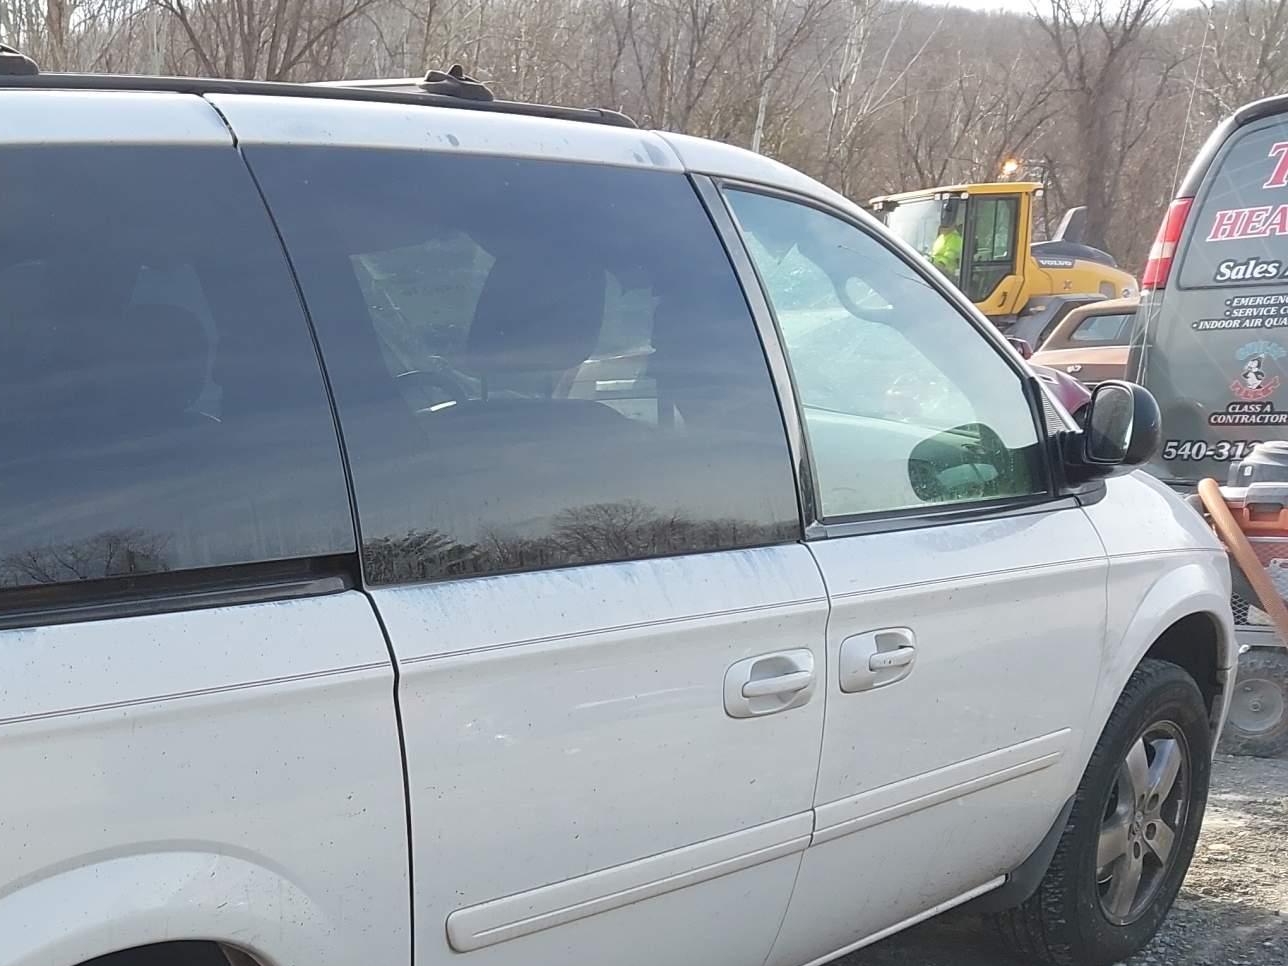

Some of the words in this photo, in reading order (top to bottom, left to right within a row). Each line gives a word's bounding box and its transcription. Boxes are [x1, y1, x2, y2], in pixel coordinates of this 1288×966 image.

[1215, 258, 1280, 281] Sales
[1231, 306, 1279, 317] SERVICE
[1198, 319, 1240, 330] INDOOR
[1241, 318, 1263, 328] AIR
[1228, 404, 1261, 413] CLASS
[1262, 404, 1272, 413] A
[1210, 414, 1288, 424] CONTRACTOR
